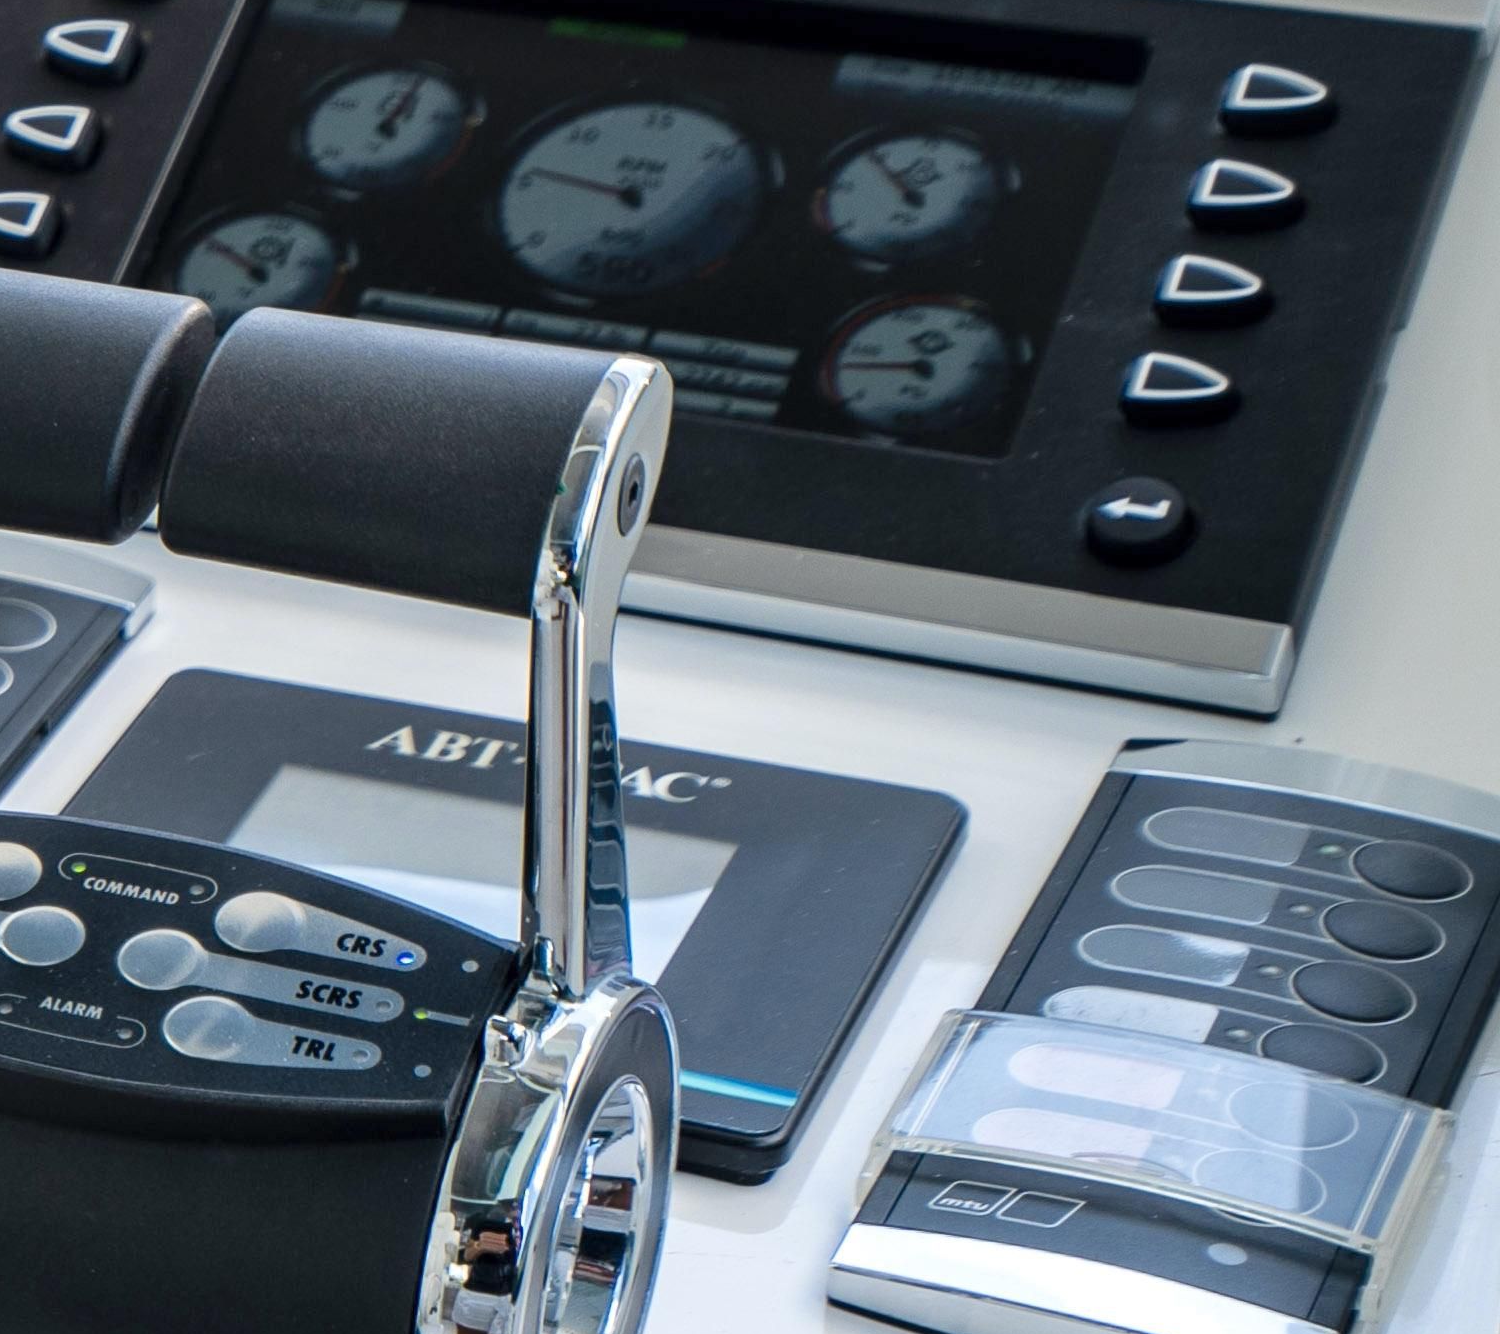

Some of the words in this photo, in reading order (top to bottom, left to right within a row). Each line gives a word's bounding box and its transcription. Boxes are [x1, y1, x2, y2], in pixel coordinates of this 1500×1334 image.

[82, 876, 181, 906] COMMAND
[336, 933, 388, 958] CRS
[38, 995, 104, 1020] ALARM
[295, 979, 363, 1010] SCRS
[291, 1035, 337, 1062] TRL
[938, 1197, 991, 1211] mtu
